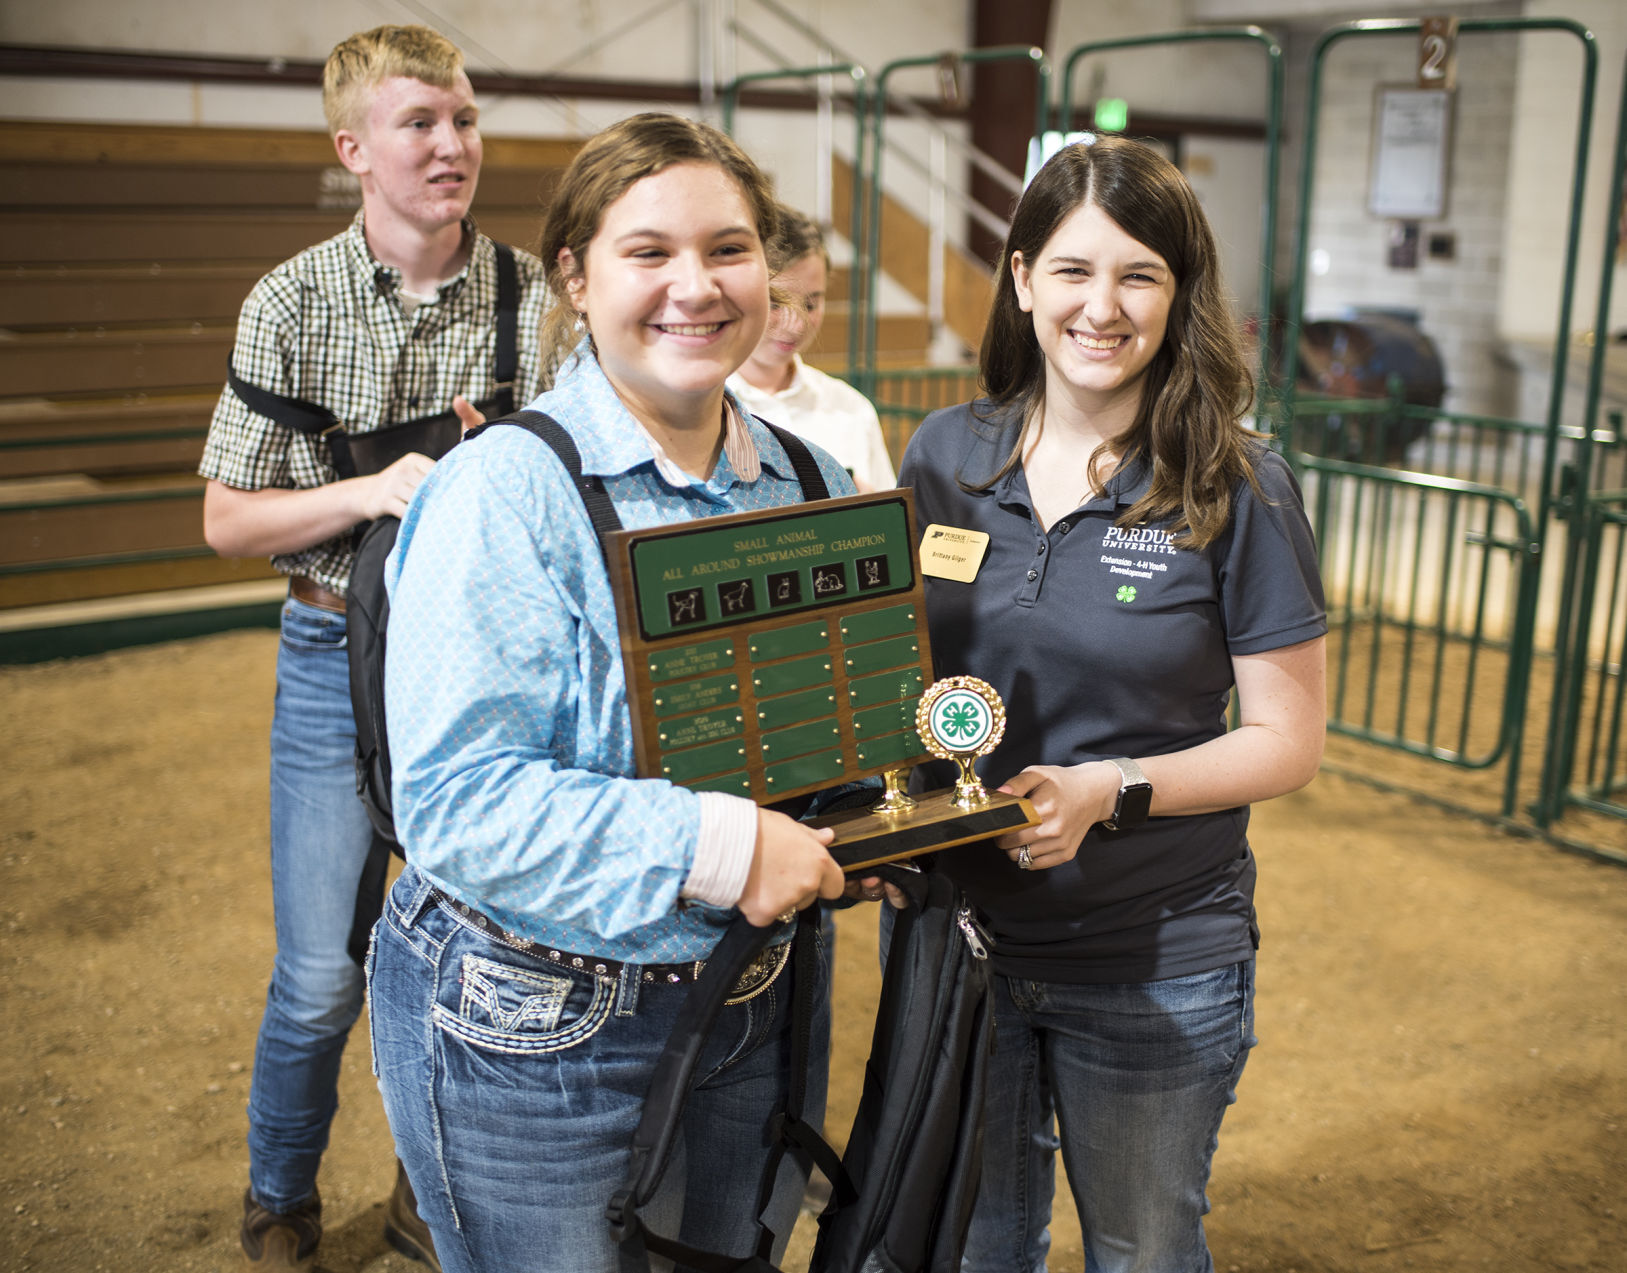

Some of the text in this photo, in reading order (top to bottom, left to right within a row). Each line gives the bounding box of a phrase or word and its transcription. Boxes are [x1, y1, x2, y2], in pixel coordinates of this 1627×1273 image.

[1421, 35, 1446, 79] 2
[734, 529, 817, 551] SMALL ANIMAL
[662, 533, 886, 580] ALL AROUND SHOWMANSHIP CHAMPION
[1100, 555, 1132, 567] Extension
[1136, 560, 1149, 569] 4-H
[1149, 562, 1168, 571] Youth
[1110, 565, 1153, 579] Development
